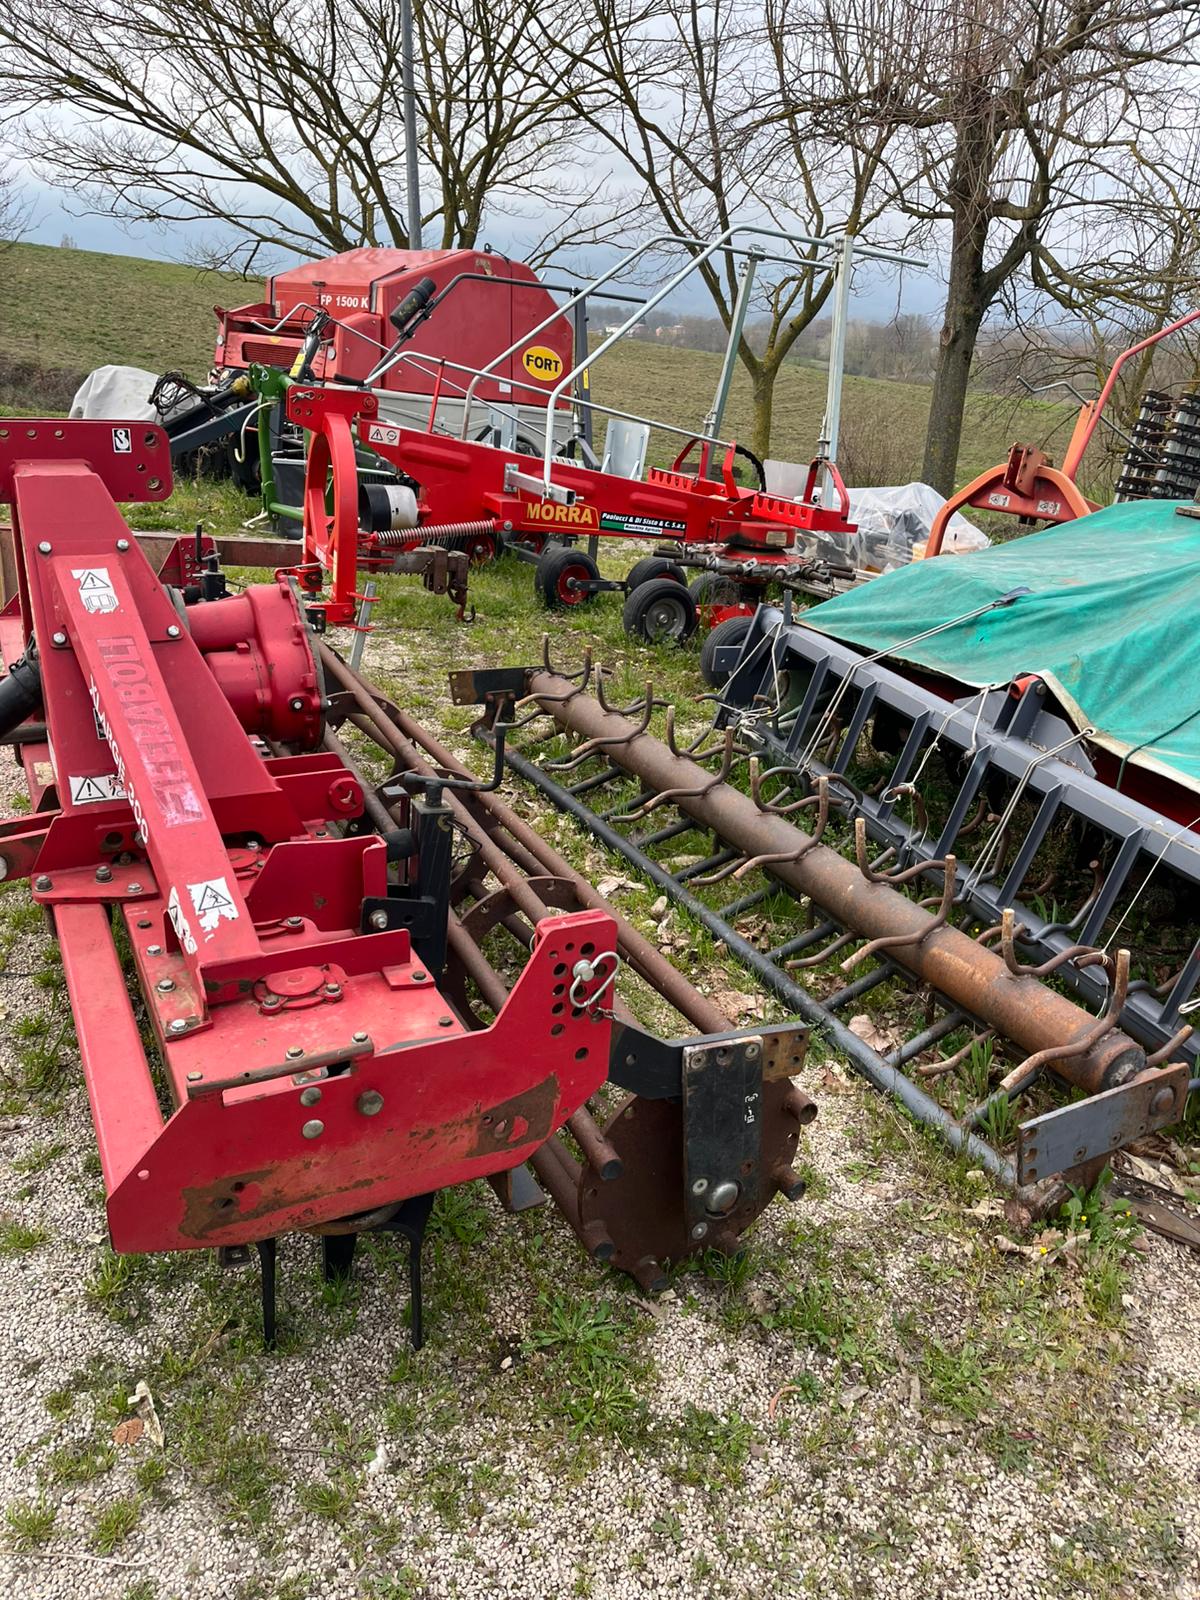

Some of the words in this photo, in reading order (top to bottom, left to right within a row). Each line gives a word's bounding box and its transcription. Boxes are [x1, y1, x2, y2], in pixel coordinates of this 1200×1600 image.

[320, 294, 333, 306] FP
[336, 295, 359, 308] 1500
[360, 296, 369, 309] K
[525, 354, 560, 373] FORT
[526, 502, 593, 524] MORRA
[602, 512, 629, 523] Paolucci
[643, 518, 659, 526] Sisto
[96, 636, 189, 785] FERABOLI
[127, 782, 149, 844] 300
